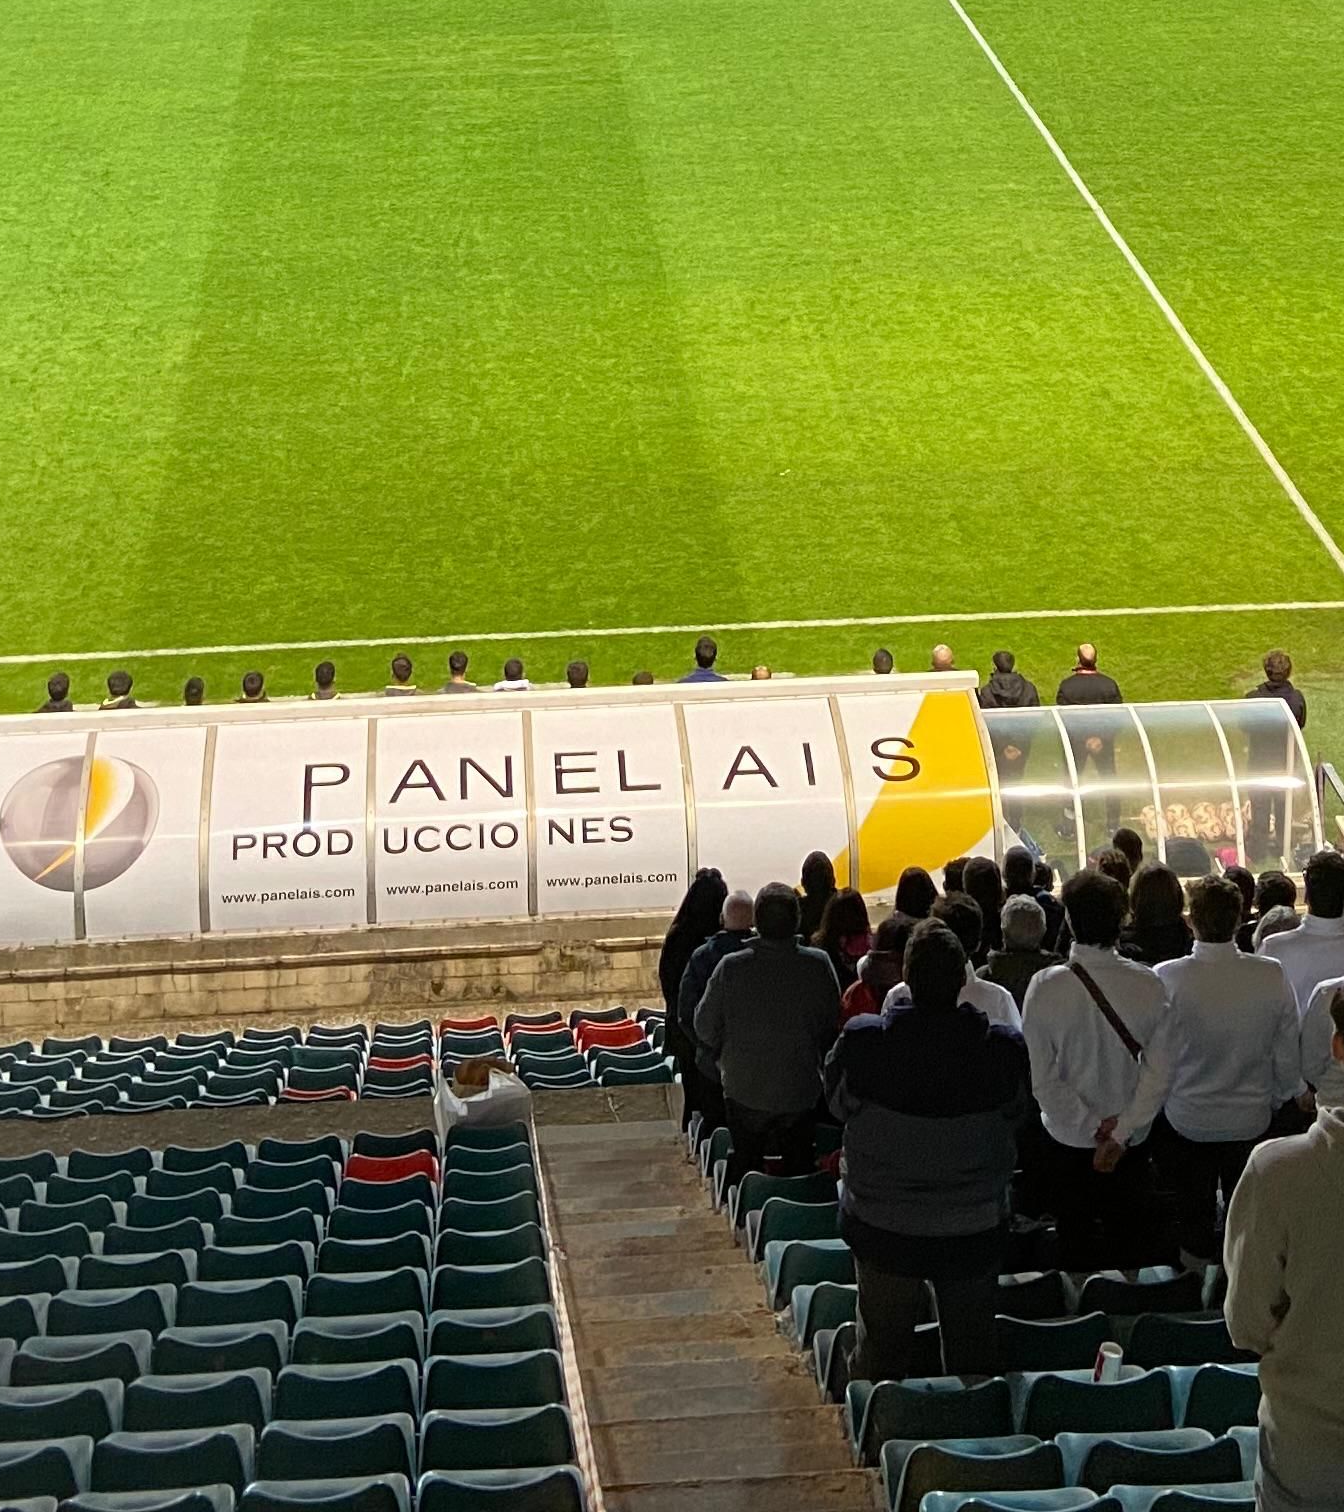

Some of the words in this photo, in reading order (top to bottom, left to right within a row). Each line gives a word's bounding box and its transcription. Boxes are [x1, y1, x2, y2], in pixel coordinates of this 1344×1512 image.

[385, 878, 519, 897] www.panelais.com
[546, 870, 678, 889] www.panelais.com
[221, 886, 356, 906] www.panelais.com
